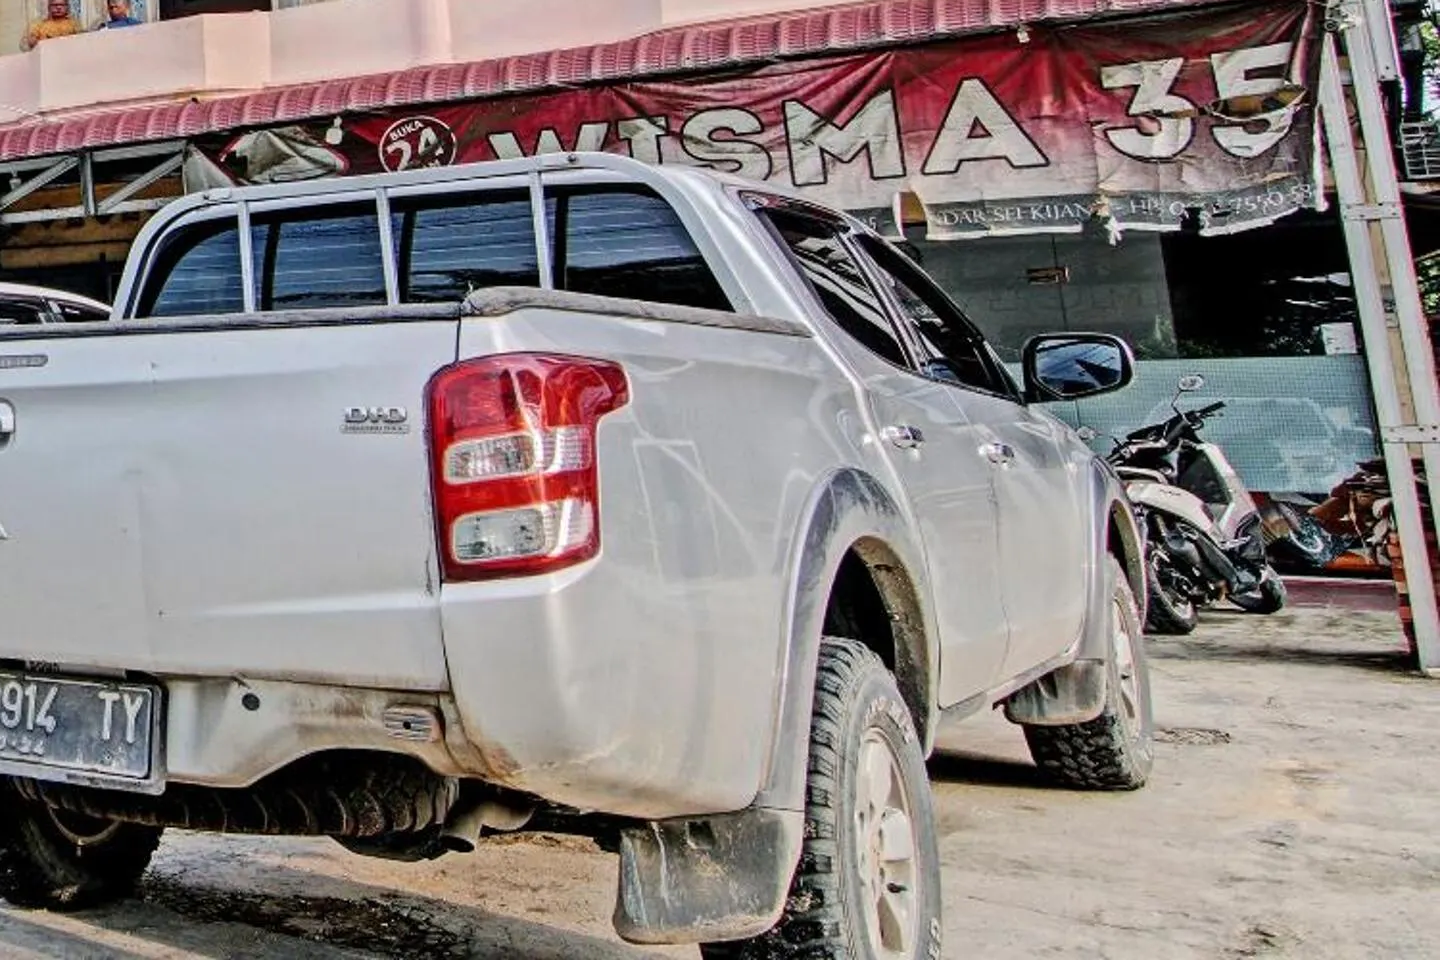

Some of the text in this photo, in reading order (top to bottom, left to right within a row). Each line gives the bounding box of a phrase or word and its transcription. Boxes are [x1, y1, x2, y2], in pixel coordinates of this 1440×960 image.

[1100, 41, 1296, 163] 35
[389, 120, 424, 141] BUKA
[1031, 202, 1092, 221] KIJAN
[98, 691, 144, 745] TY
